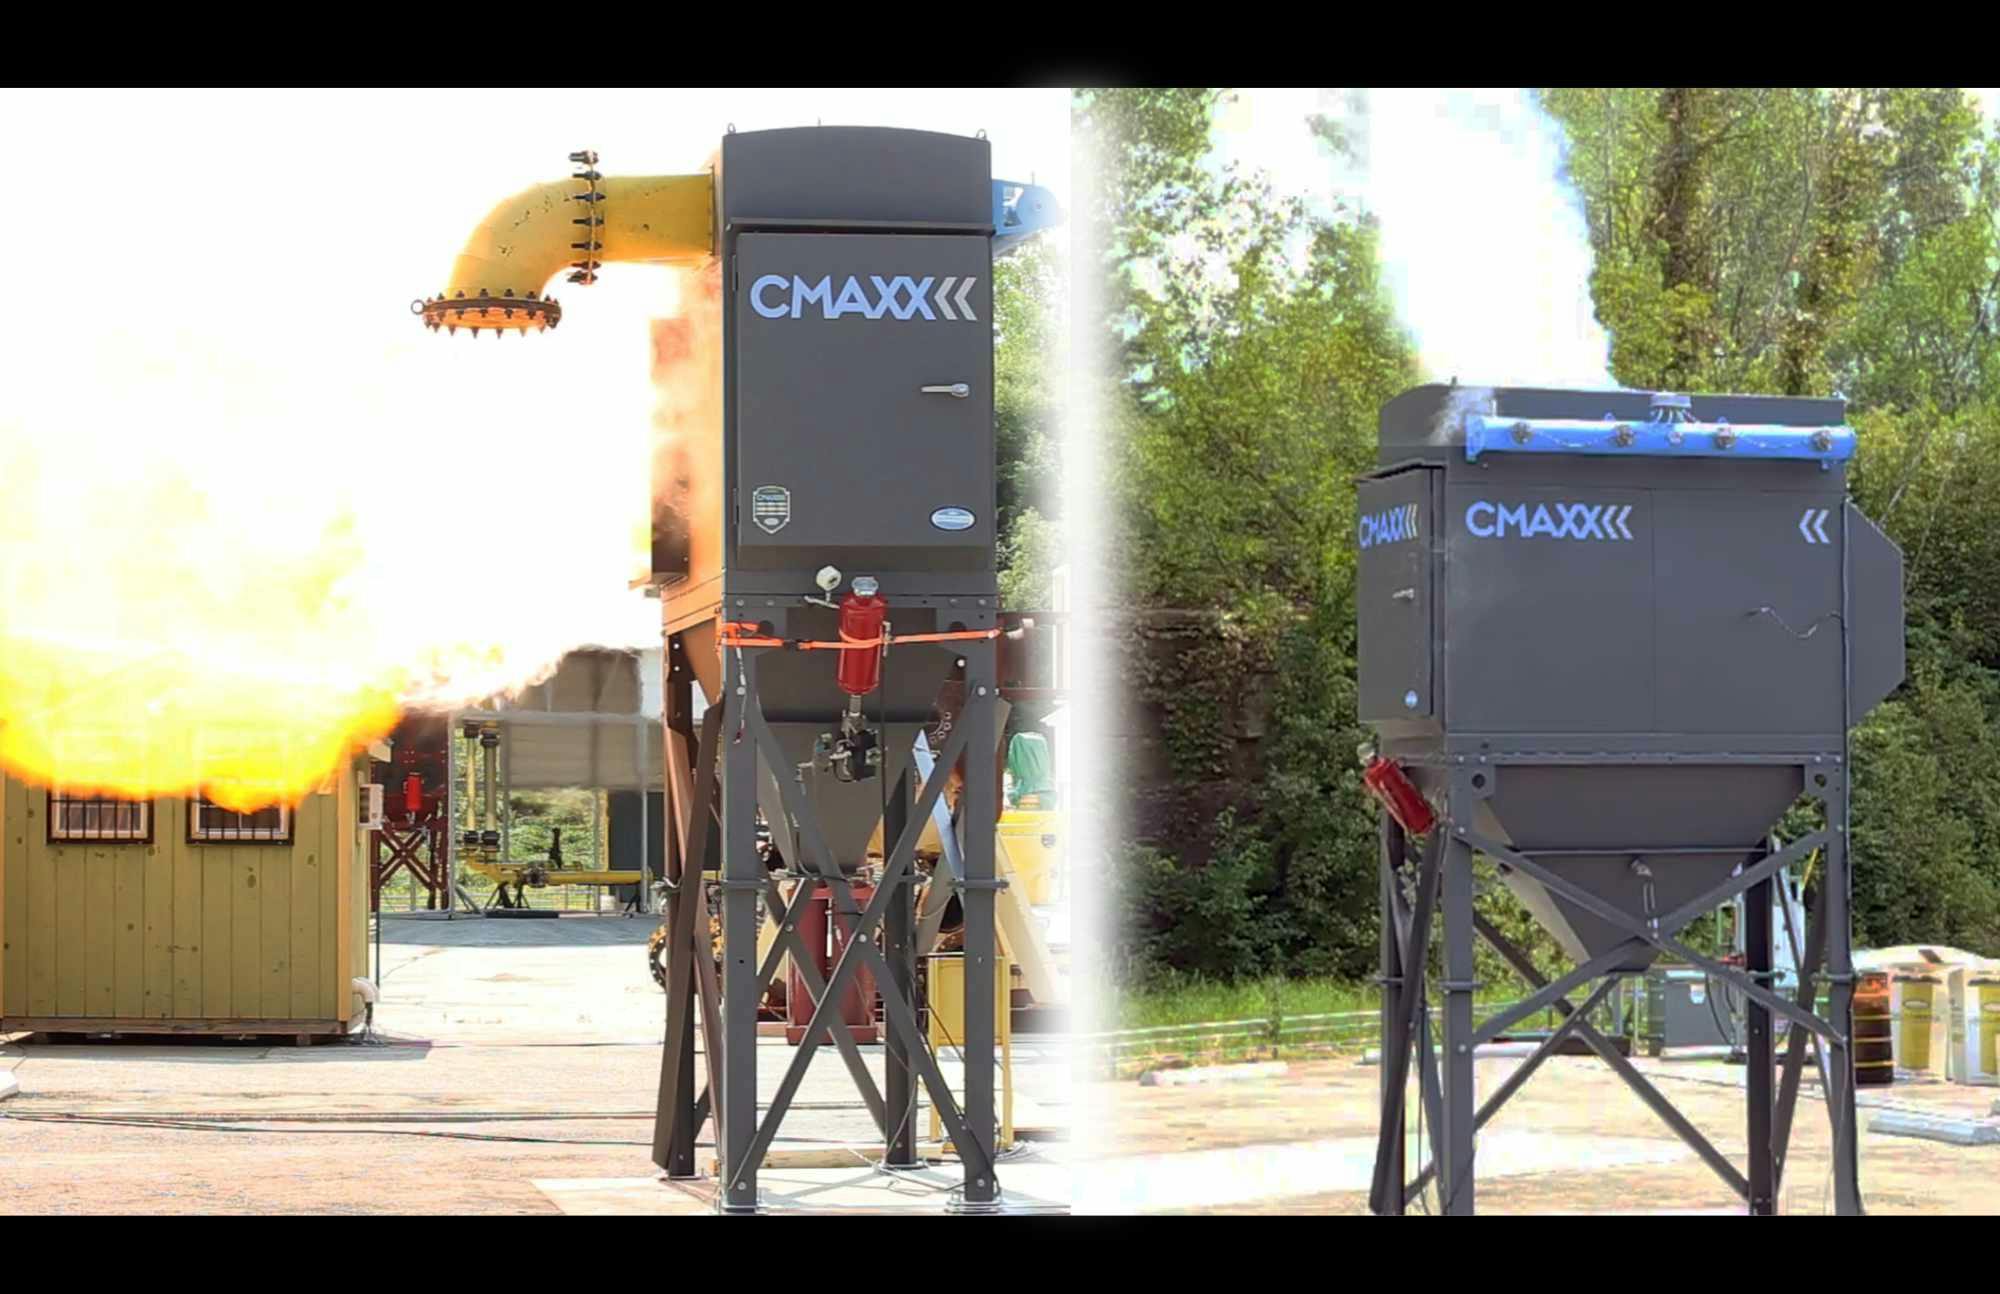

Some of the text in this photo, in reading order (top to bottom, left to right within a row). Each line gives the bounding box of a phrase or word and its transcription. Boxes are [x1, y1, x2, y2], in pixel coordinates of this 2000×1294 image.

[750, 274, 936, 320] CMAXX
[1359, 506, 1406, 549] CMAXX
[1465, 501, 1604, 540] CMAXX
